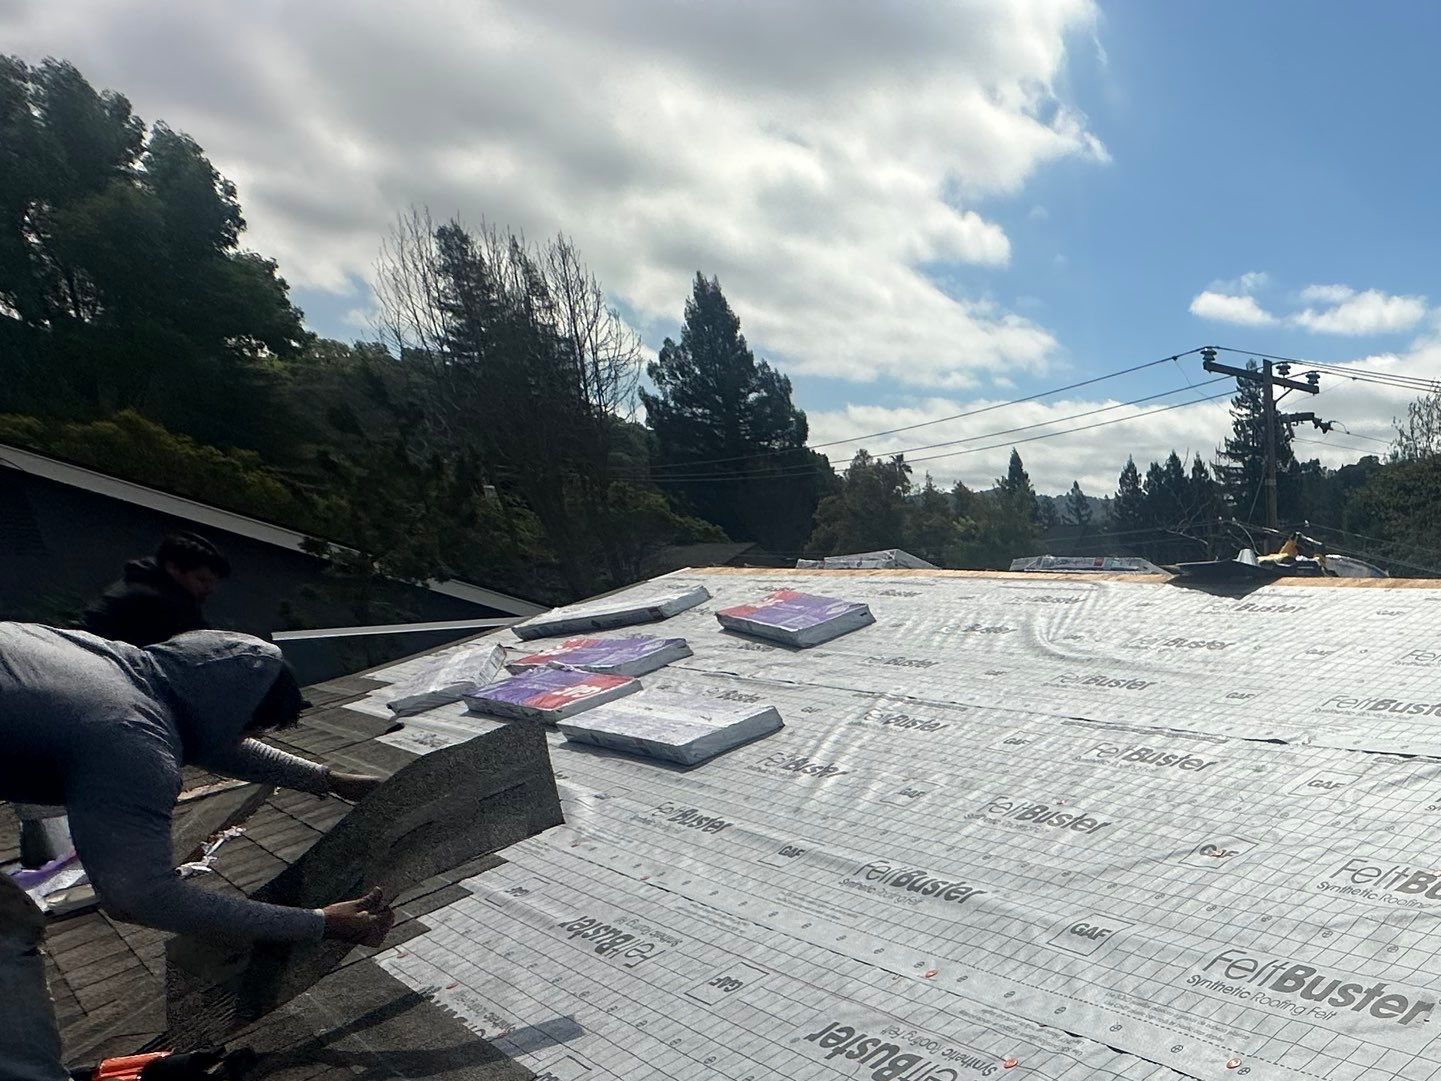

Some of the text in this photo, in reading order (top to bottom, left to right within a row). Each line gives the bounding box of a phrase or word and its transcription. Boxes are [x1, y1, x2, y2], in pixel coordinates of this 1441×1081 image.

[1307, 777, 1347, 792] GAF
[1069, 921, 1112, 943] GAF
[1186, 973, 1251, 1000] Synthetic
[1253, 991, 1307, 1018] Roofing
[1308, 1003, 1337, 1021] Felt
